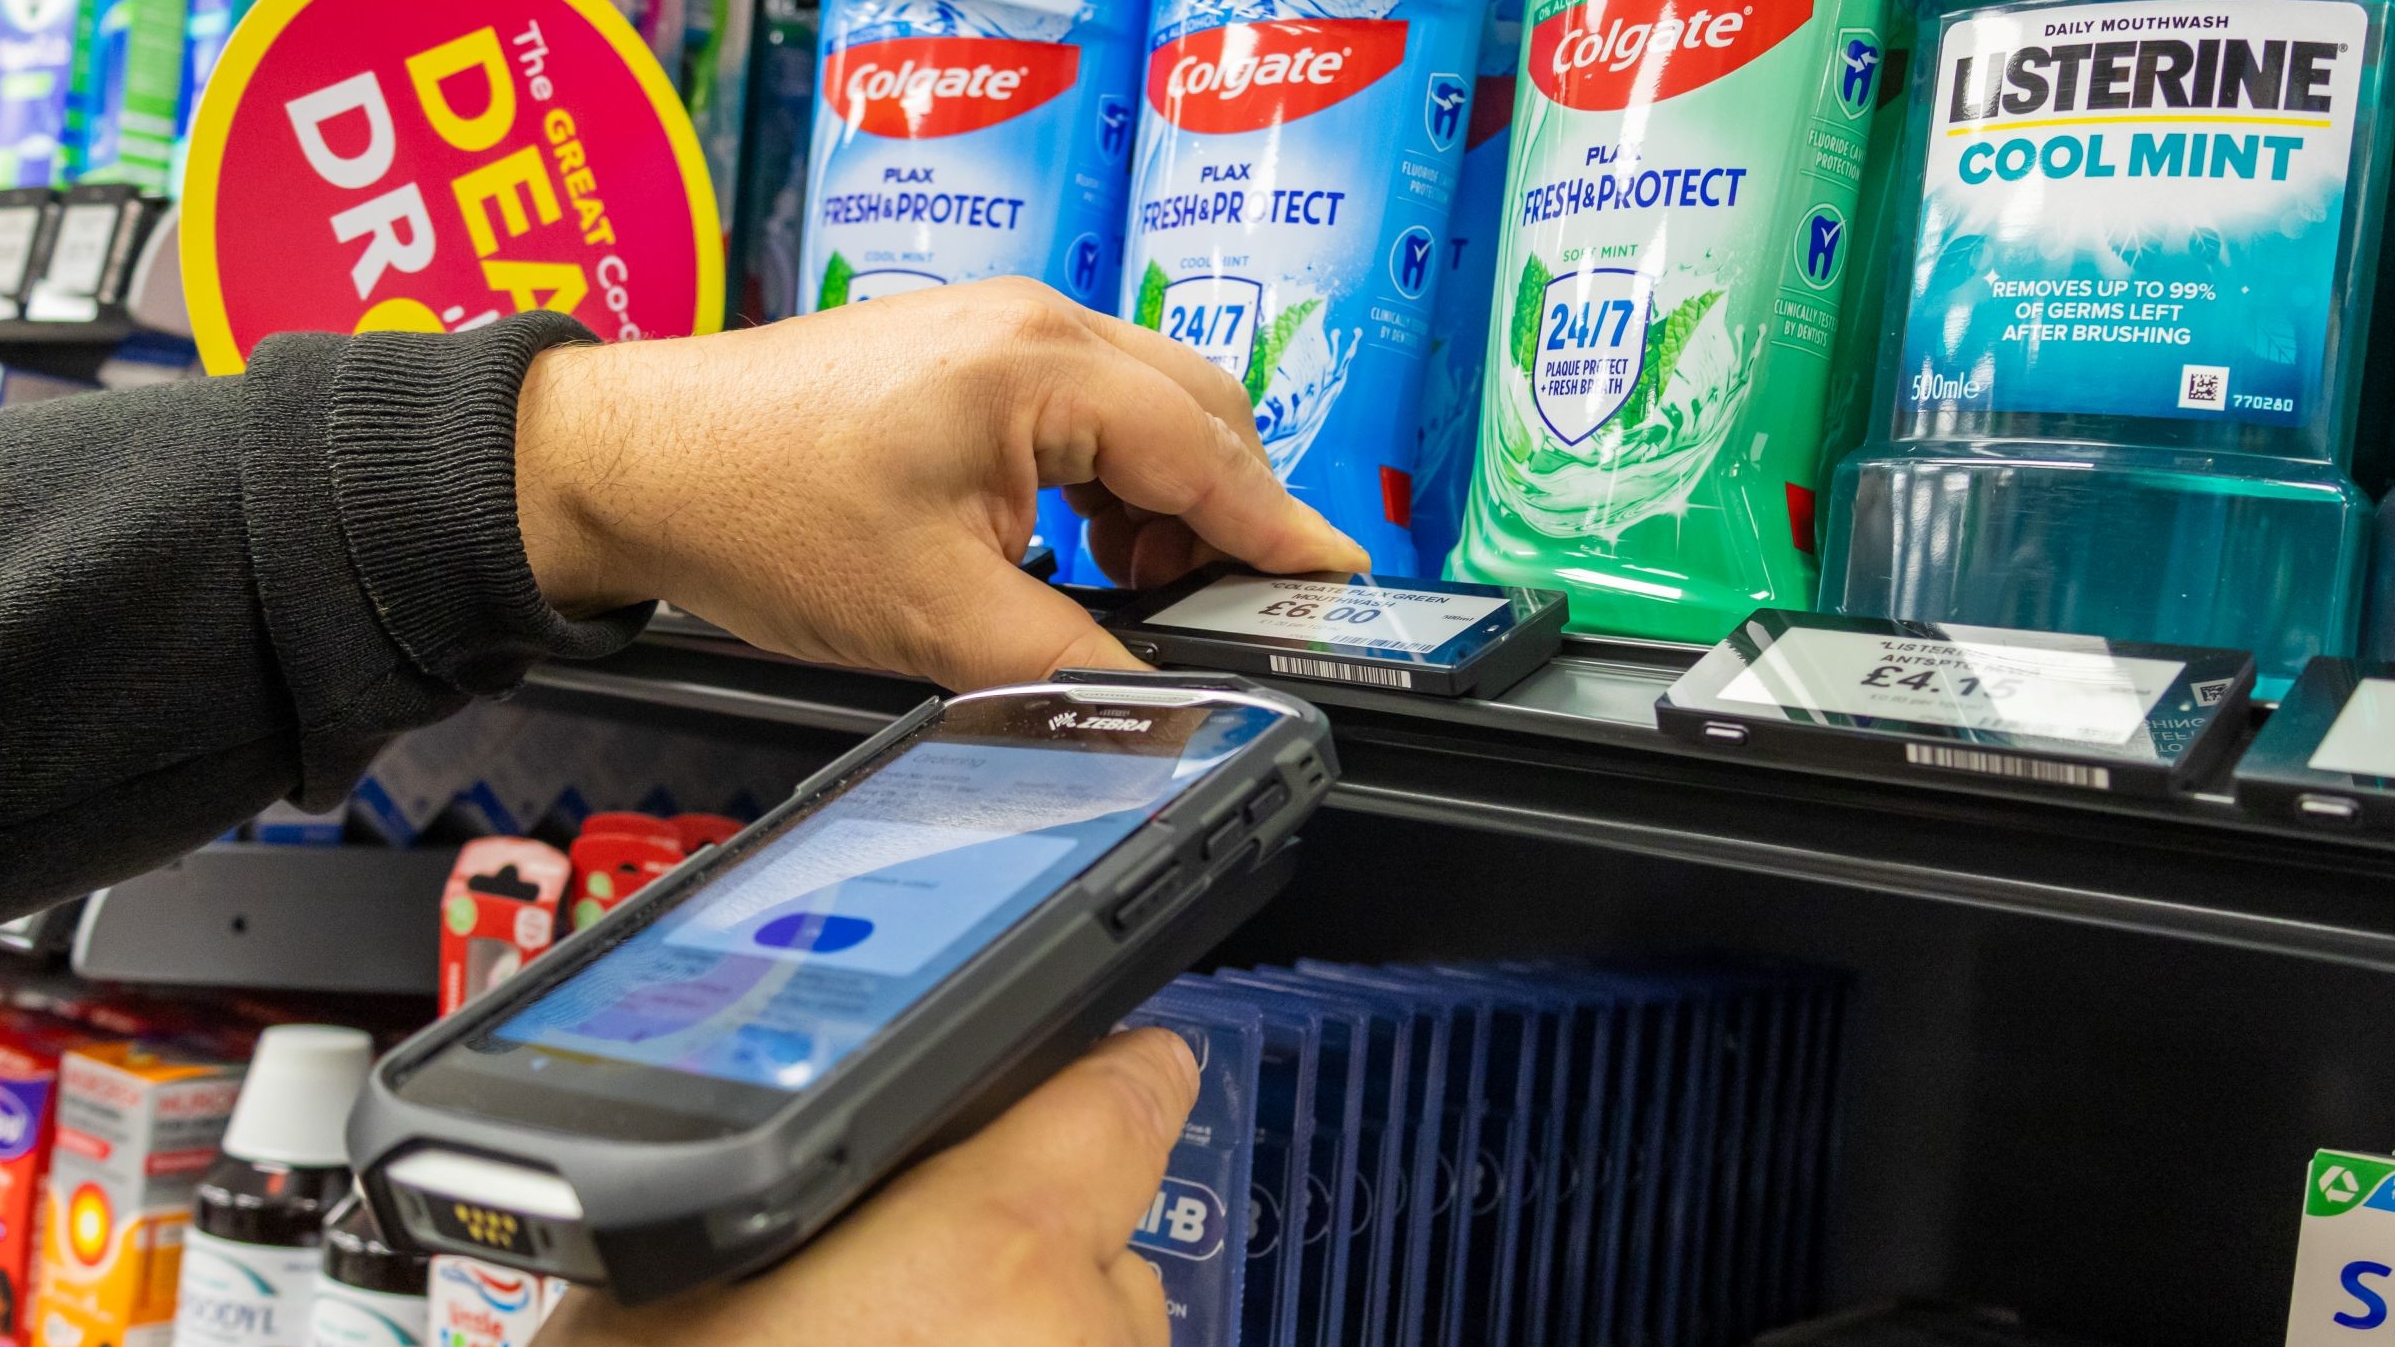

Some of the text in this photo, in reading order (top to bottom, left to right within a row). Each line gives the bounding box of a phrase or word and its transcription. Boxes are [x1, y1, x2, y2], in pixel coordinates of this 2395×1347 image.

[2045, 14, 2231, 37] DAILY MOUTHWASH
[1552, 6, 1745, 73] Colgate
[846, 60, 1022, 106] Colgate
[1166, 46, 1345, 101] Colgate
[1948, 38, 2340, 124] LISTERINE
[512, 20, 553, 101] The
[543, 109, 616, 246] GREAT
[1808, 129, 1850, 157] FLUORIDE
[1815, 153, 1861, 181] PROTECTION
[1958, 132, 2305, 186] COOL MINT
[883, 167, 934, 184] PLAX
[1200, 163, 1252, 183] PLAX
[1180, 257, 1212, 269] COOL
[1601, 244, 1639, 259] MINT
[1992, 280, 2217, 301] REMOVES UP TO 99%
[1773, 300, 1818, 323] CLINICALLY
[2014, 302, 2183, 322] OF GERMS LEFT
[1169, 304, 1245, 346] 24/7
[1546, 300, 1636, 352] 24/7
[1784, 320, 1828, 348] BY DENTISTS
[2001, 324, 2192, 346] AFTER BRUSHING
[1545, 359, 1629, 378] PLAQUE PROTECT
[1548, 380, 1579, 396] FRESH
[1580, 377, 1623, 394] BREATH
[1291, 593, 1396, 608] MOUTHWASH
[1393, 593, 1450, 605] GREEN
[1258, 600, 1382, 624] £6.00
[1860, 665, 2025, 700] £4.15
[1076, 716, 1152, 733] ZEBRA
